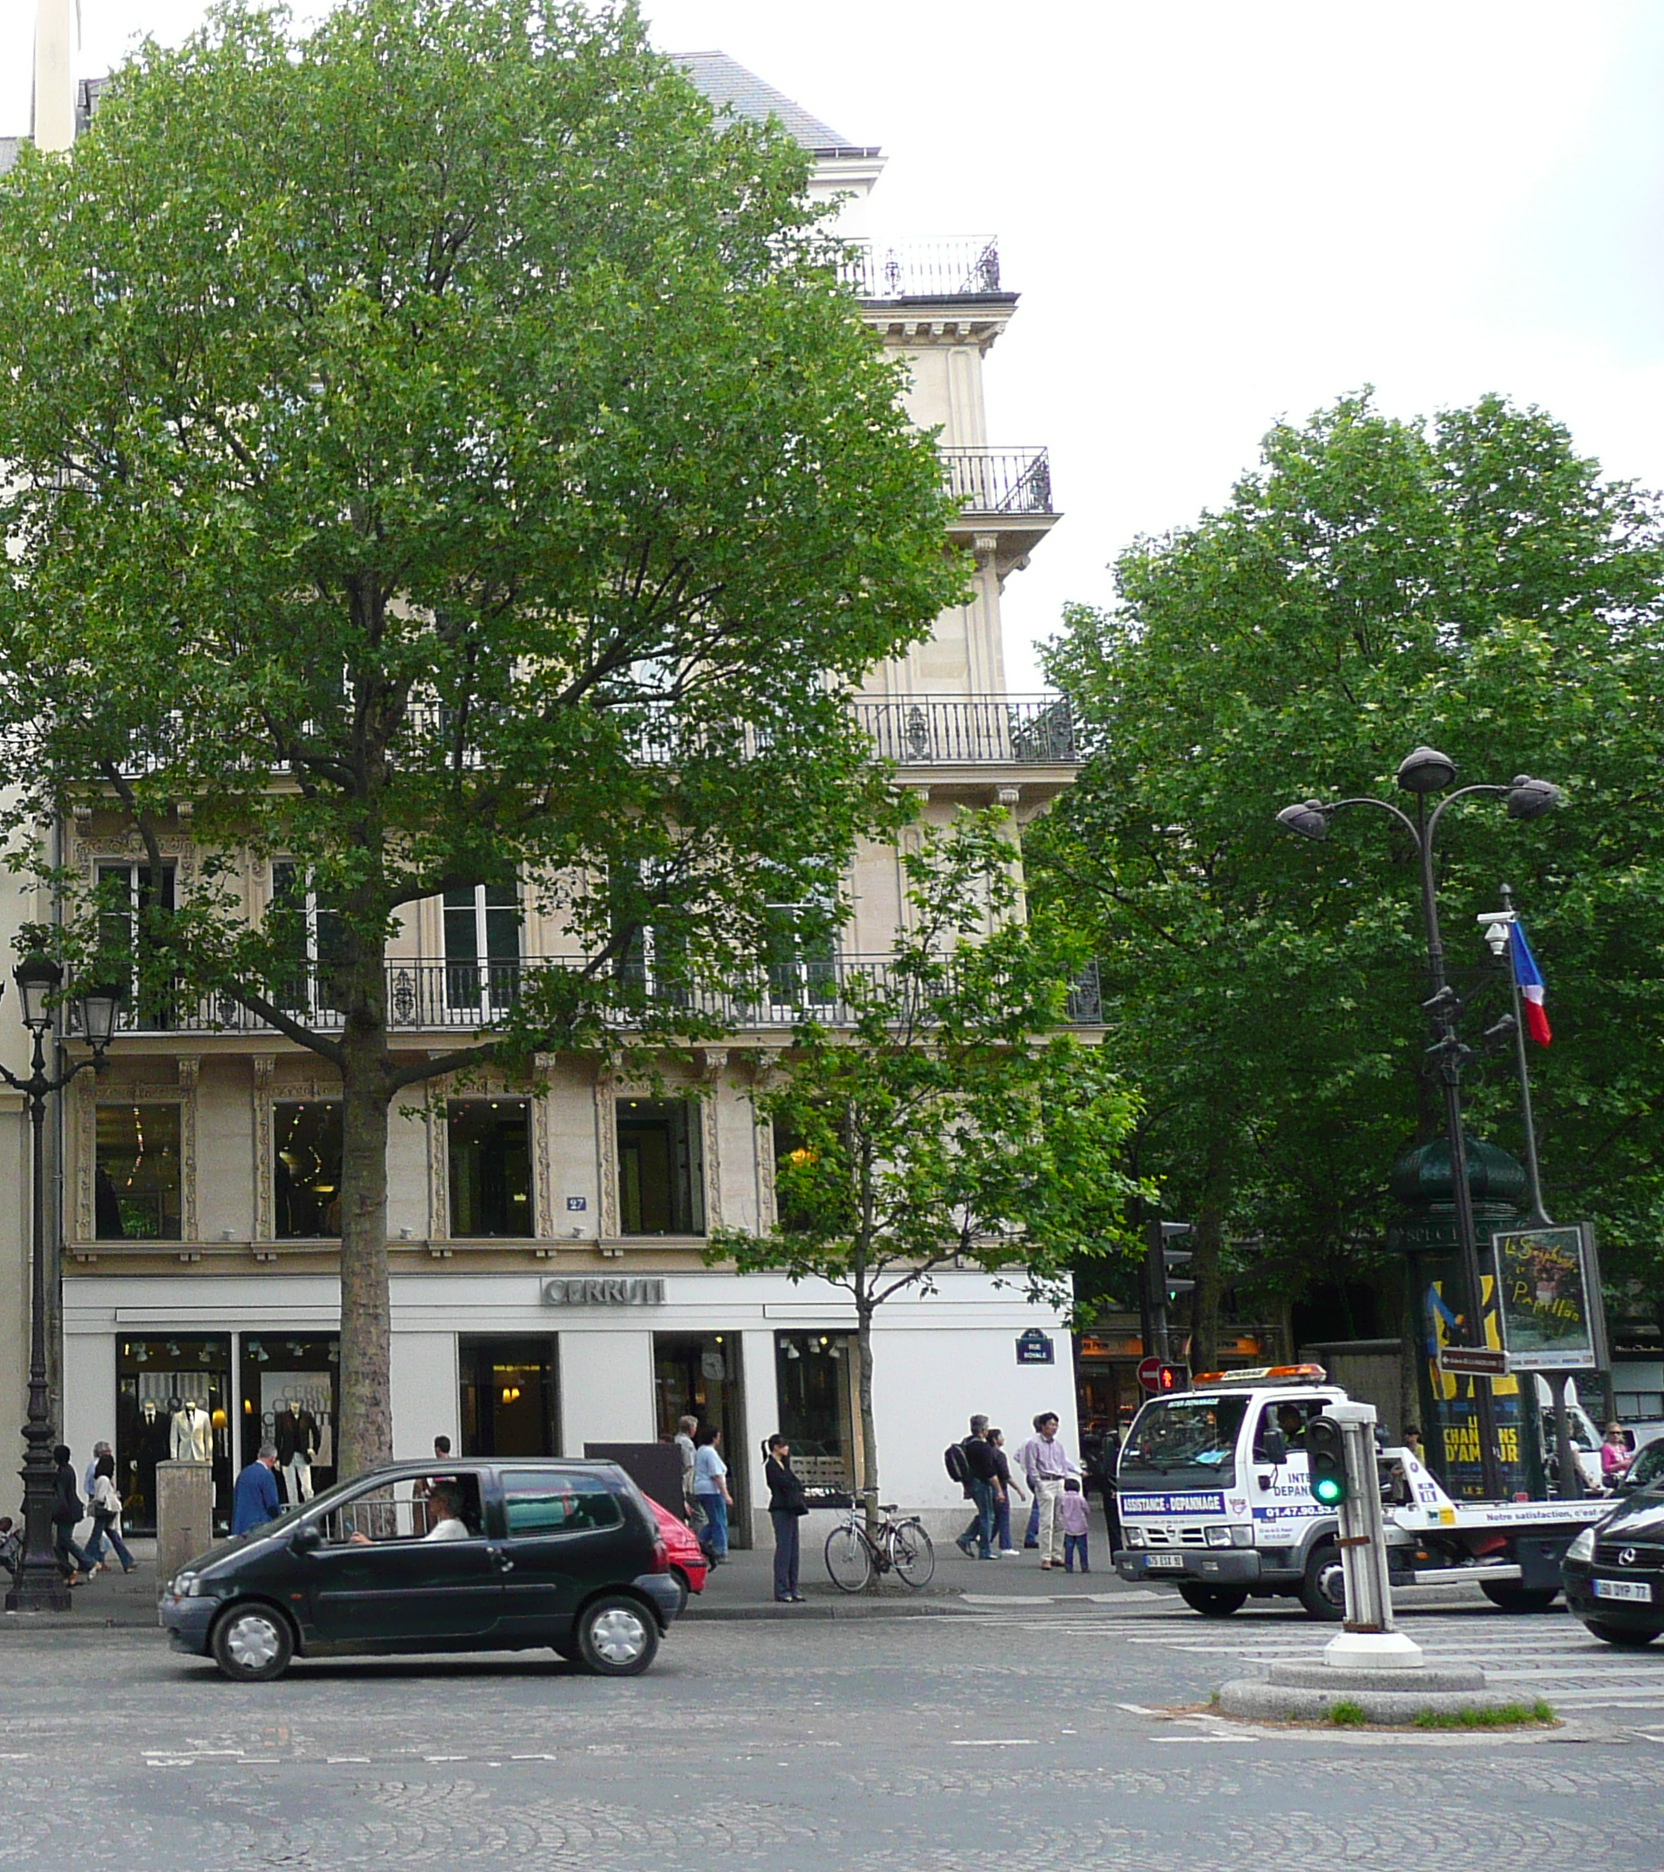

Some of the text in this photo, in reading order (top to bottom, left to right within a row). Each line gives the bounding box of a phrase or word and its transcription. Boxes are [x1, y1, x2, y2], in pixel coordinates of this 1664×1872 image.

[569, 1199, 583, 1210] 27
[543, 1279, 665, 1304] CERRUTI
[1287, 1473, 1311, 1483] INTE
[1274, 1486, 1311, 1496] DEPAN
[1123, 1498, 1165, 1512] ASSISTANCE
[1170, 1496, 1222, 1511] DEPANNAGE
[1486, 1513, 1512, 1521] Notre
[1515, 1510, 1572, 1520] satisfaction,
[1574, 1509, 1597, 1517] c'est
[1635, 1586, 1646, 1598] 77
